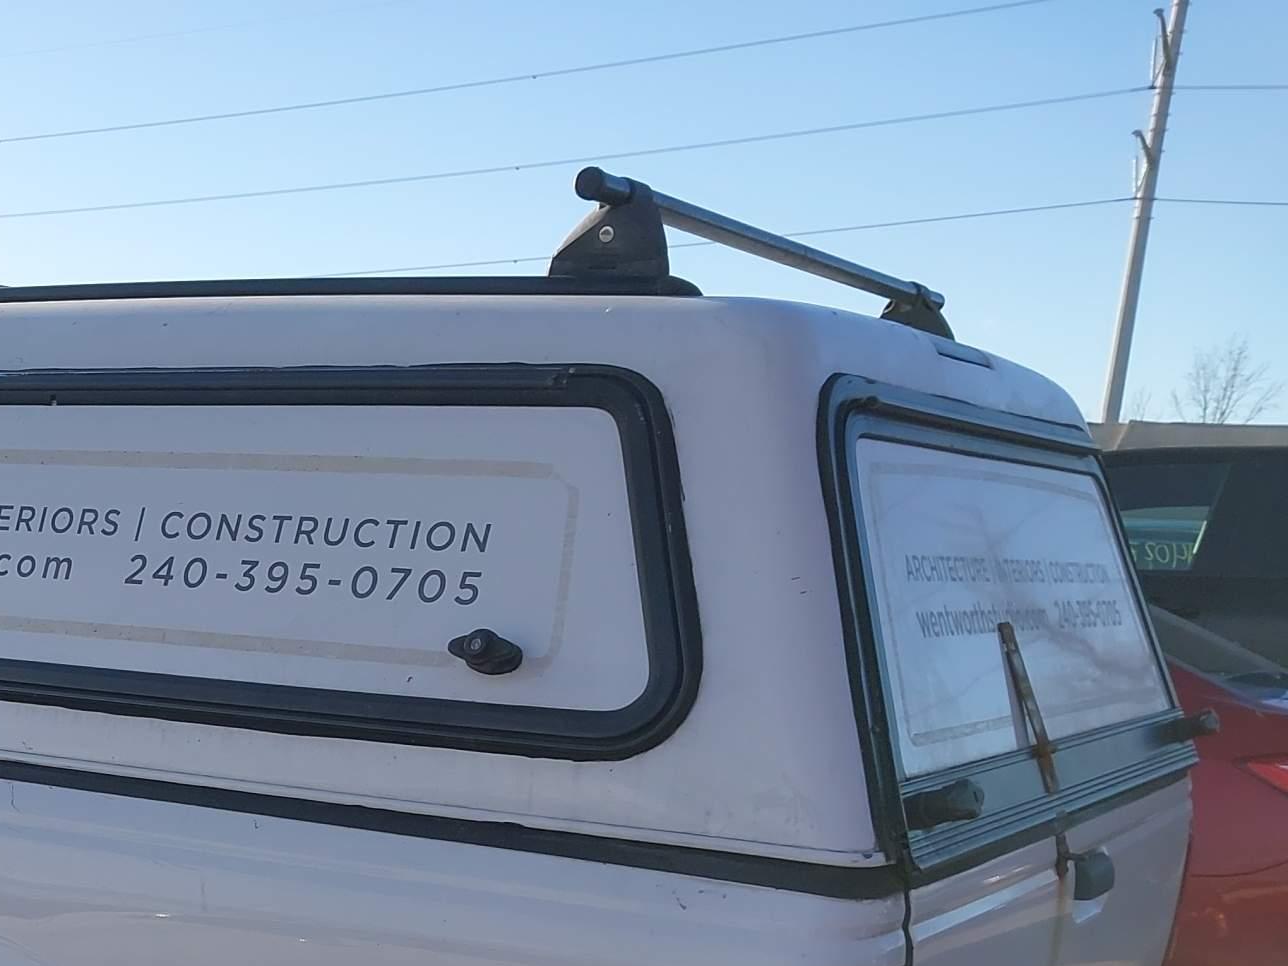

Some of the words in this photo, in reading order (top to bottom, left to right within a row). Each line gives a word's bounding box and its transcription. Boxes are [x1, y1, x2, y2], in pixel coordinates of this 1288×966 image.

[160, 511, 492, 553] CONSTRUCTION
[124, 554, 482, 606] 240-395-0705
[904, 554, 991, 582] ARCHITECTURE
